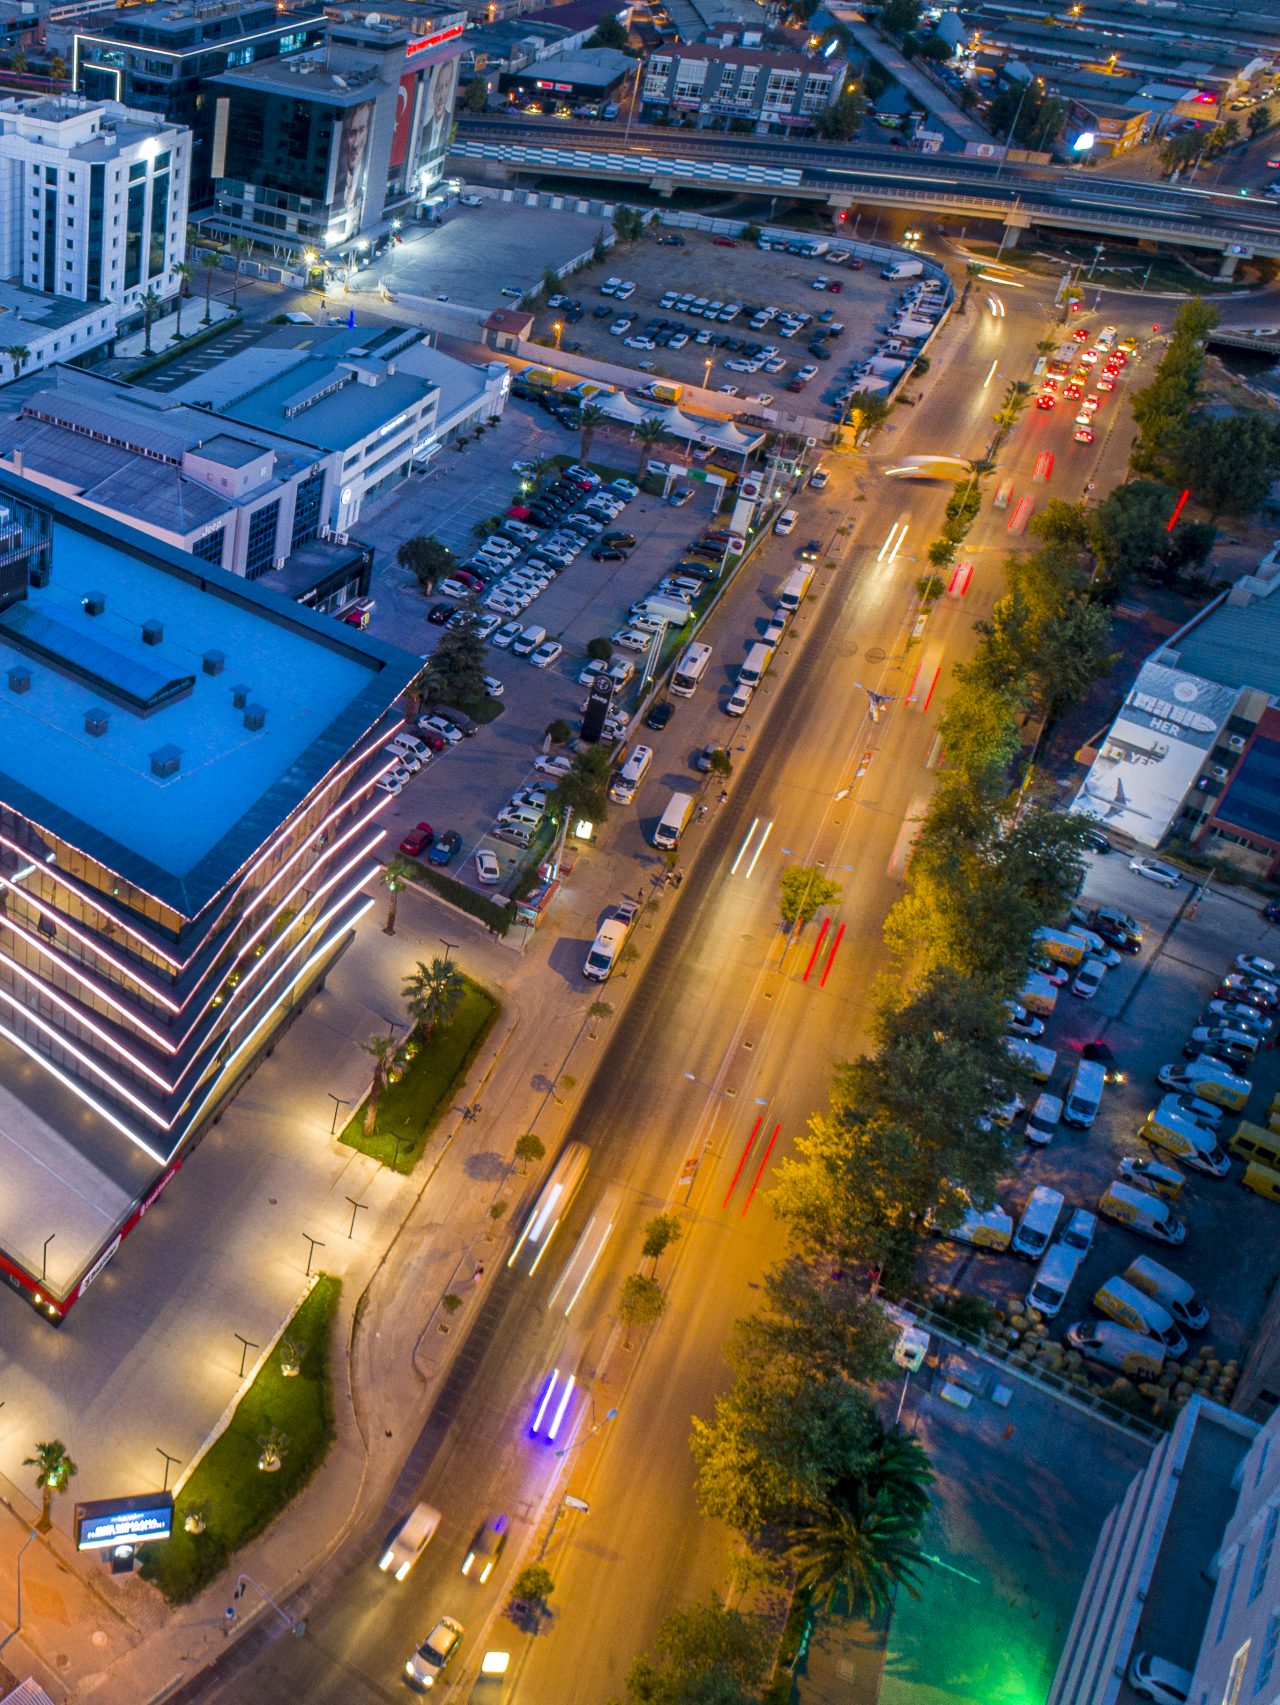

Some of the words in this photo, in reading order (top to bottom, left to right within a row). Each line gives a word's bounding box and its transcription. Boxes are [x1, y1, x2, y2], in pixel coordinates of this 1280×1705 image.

[201, 519, 222, 538] Jeep
[591, 693, 608, 704] Jeep
[1148, 717, 1181, 738] HER
